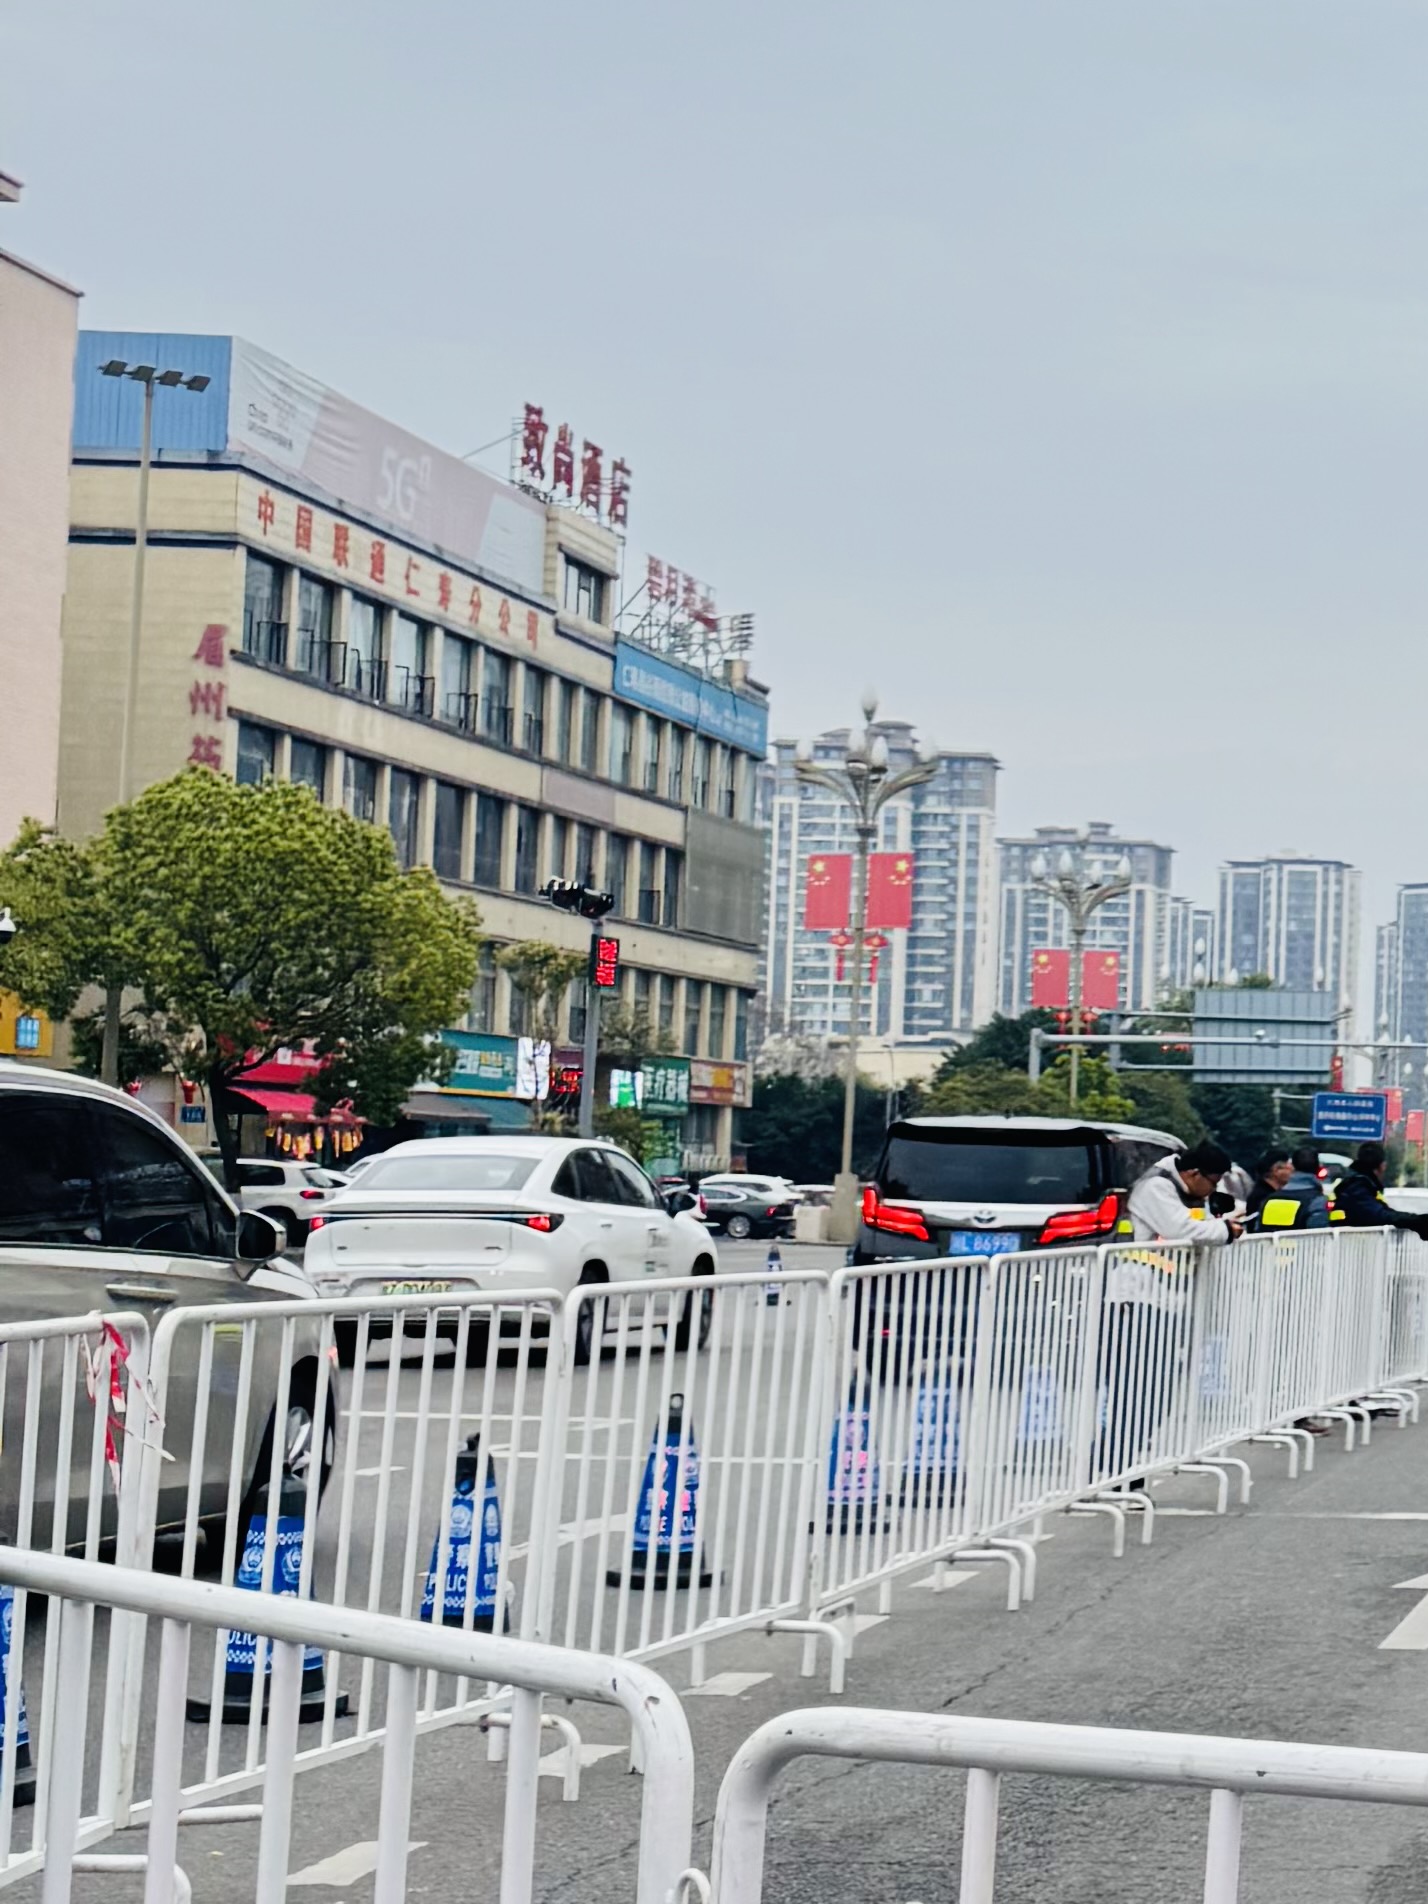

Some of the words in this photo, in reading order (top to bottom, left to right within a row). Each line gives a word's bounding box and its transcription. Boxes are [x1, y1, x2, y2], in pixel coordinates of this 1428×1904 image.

[257, 489, 539, 650] 中国联通仁寿分公司
